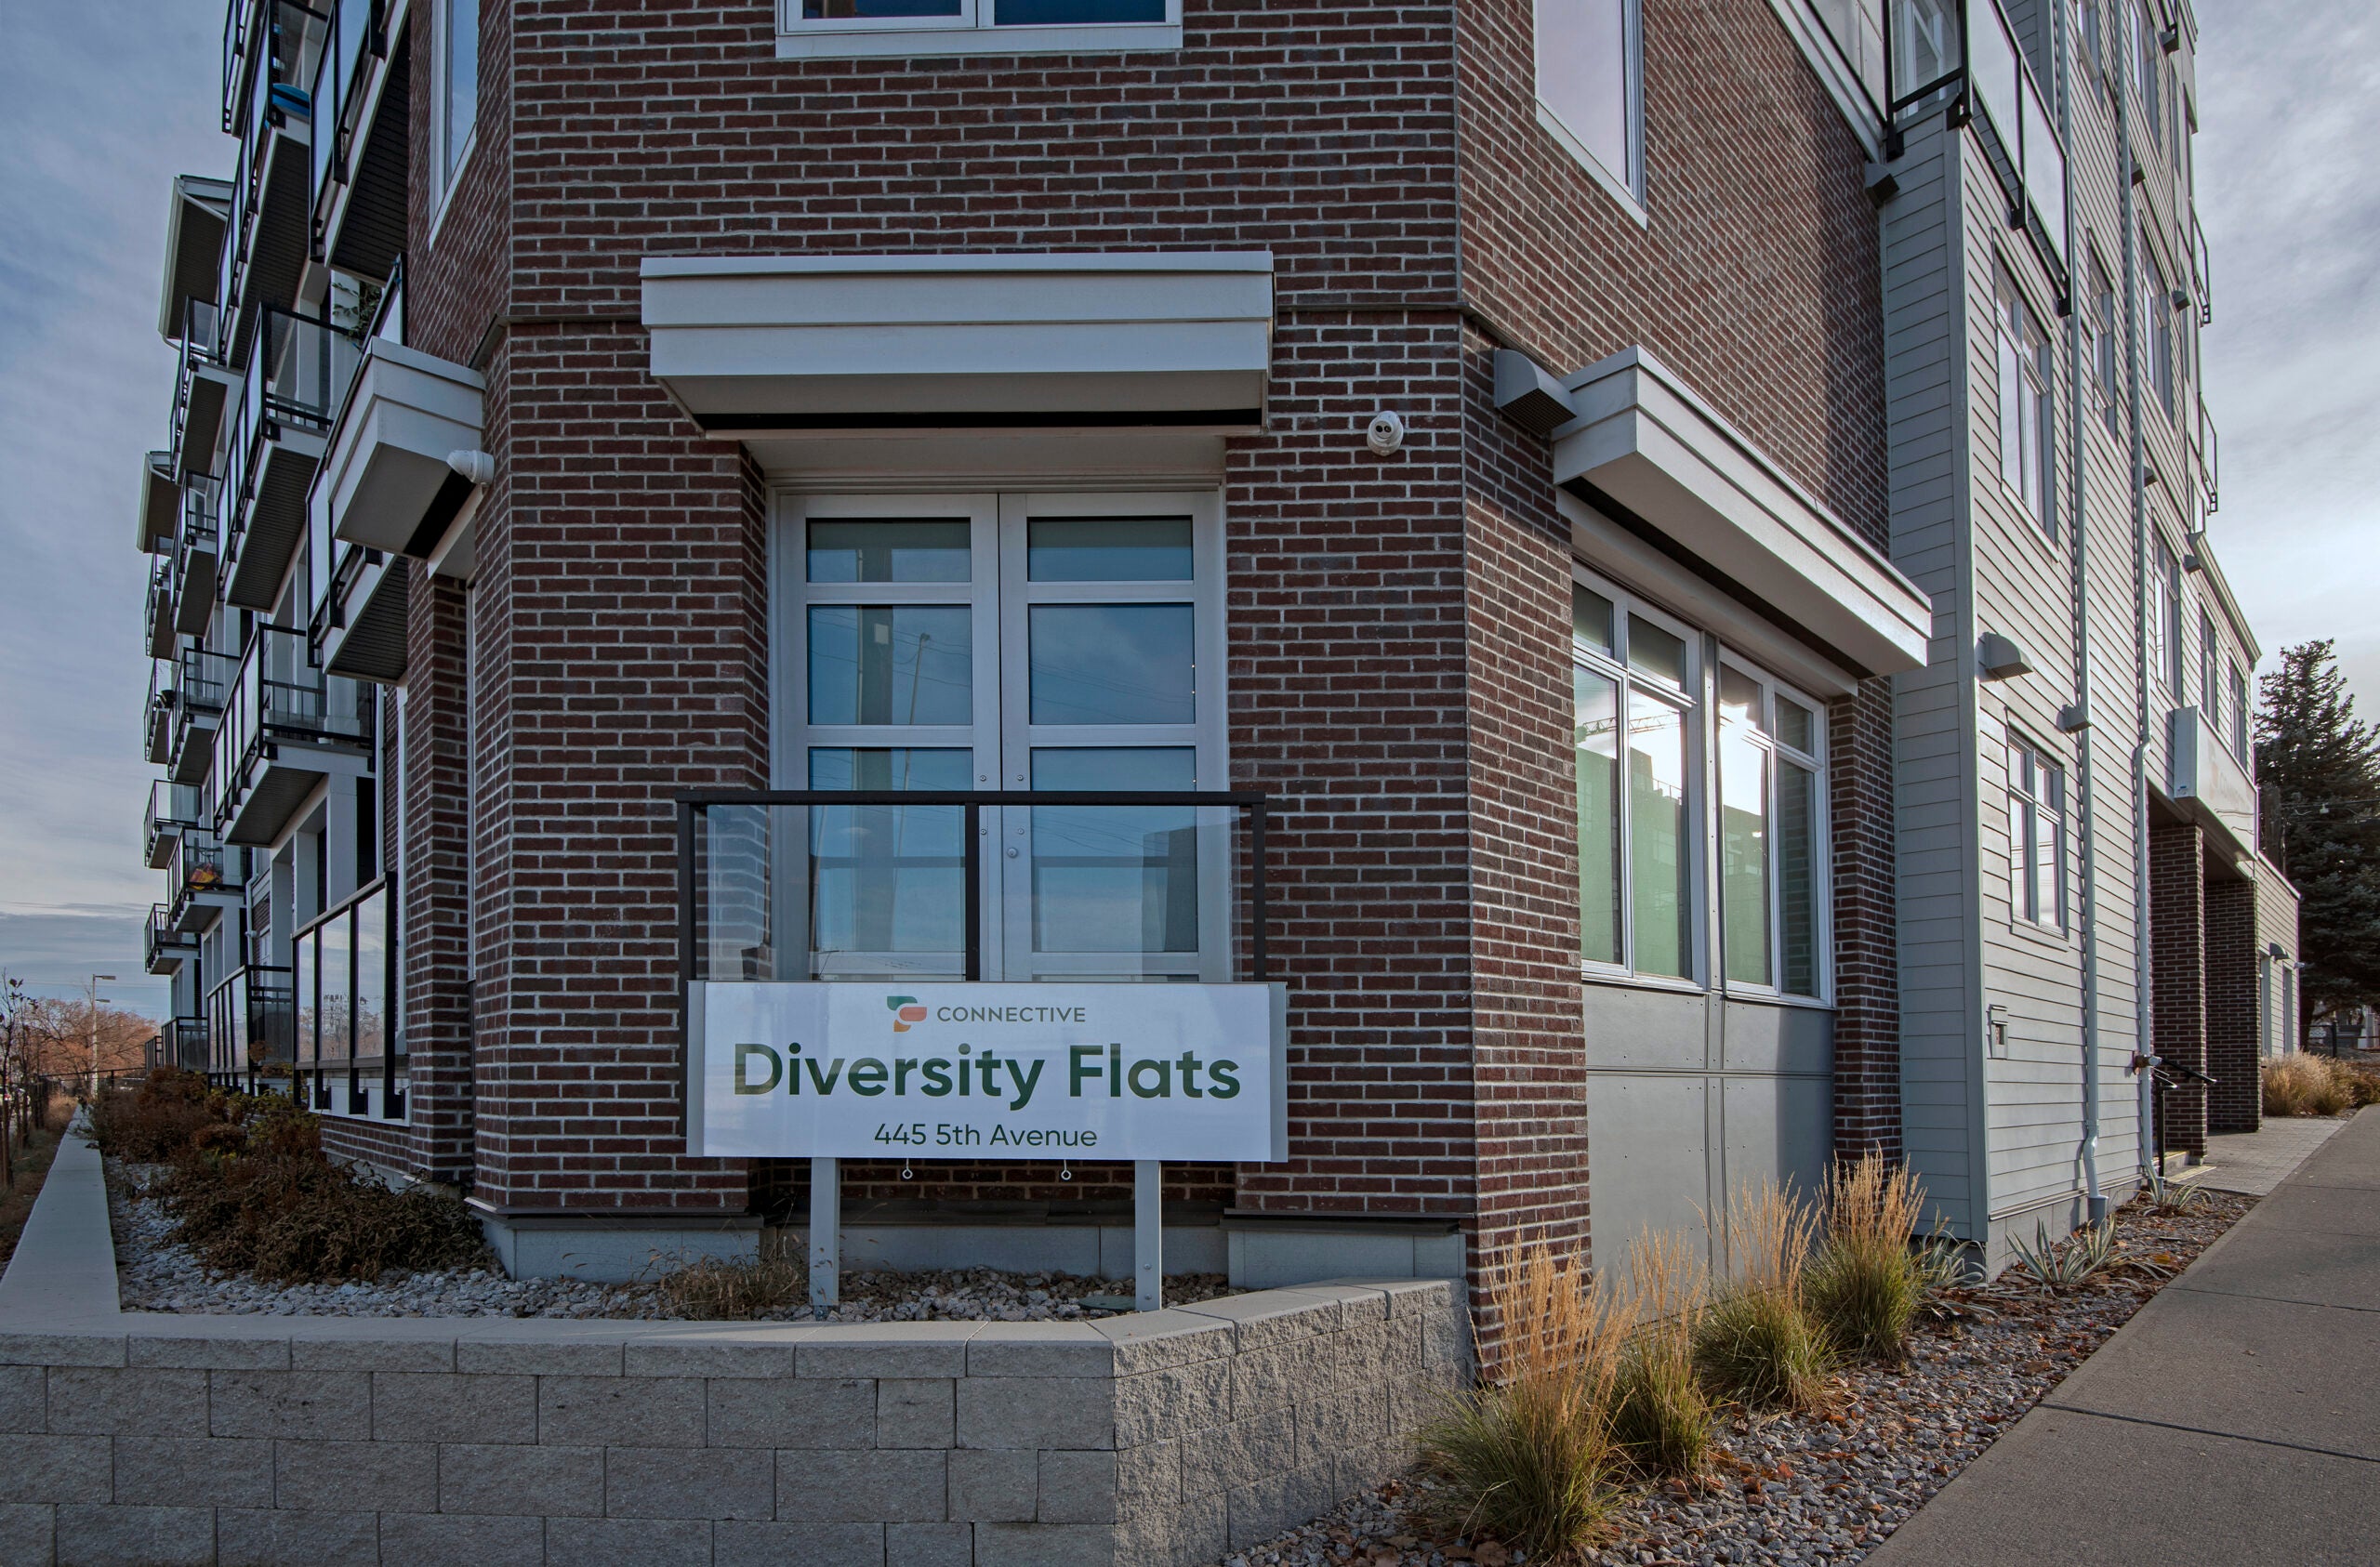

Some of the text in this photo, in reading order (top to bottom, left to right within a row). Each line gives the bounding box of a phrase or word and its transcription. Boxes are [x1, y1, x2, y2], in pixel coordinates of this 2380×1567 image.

[936, 1007, 1087, 1022] CONNECTIVE
[734, 1043, 1241, 1112] Diversity Flats
[874, 1123, 1099, 1147] 445 5th Avenue
